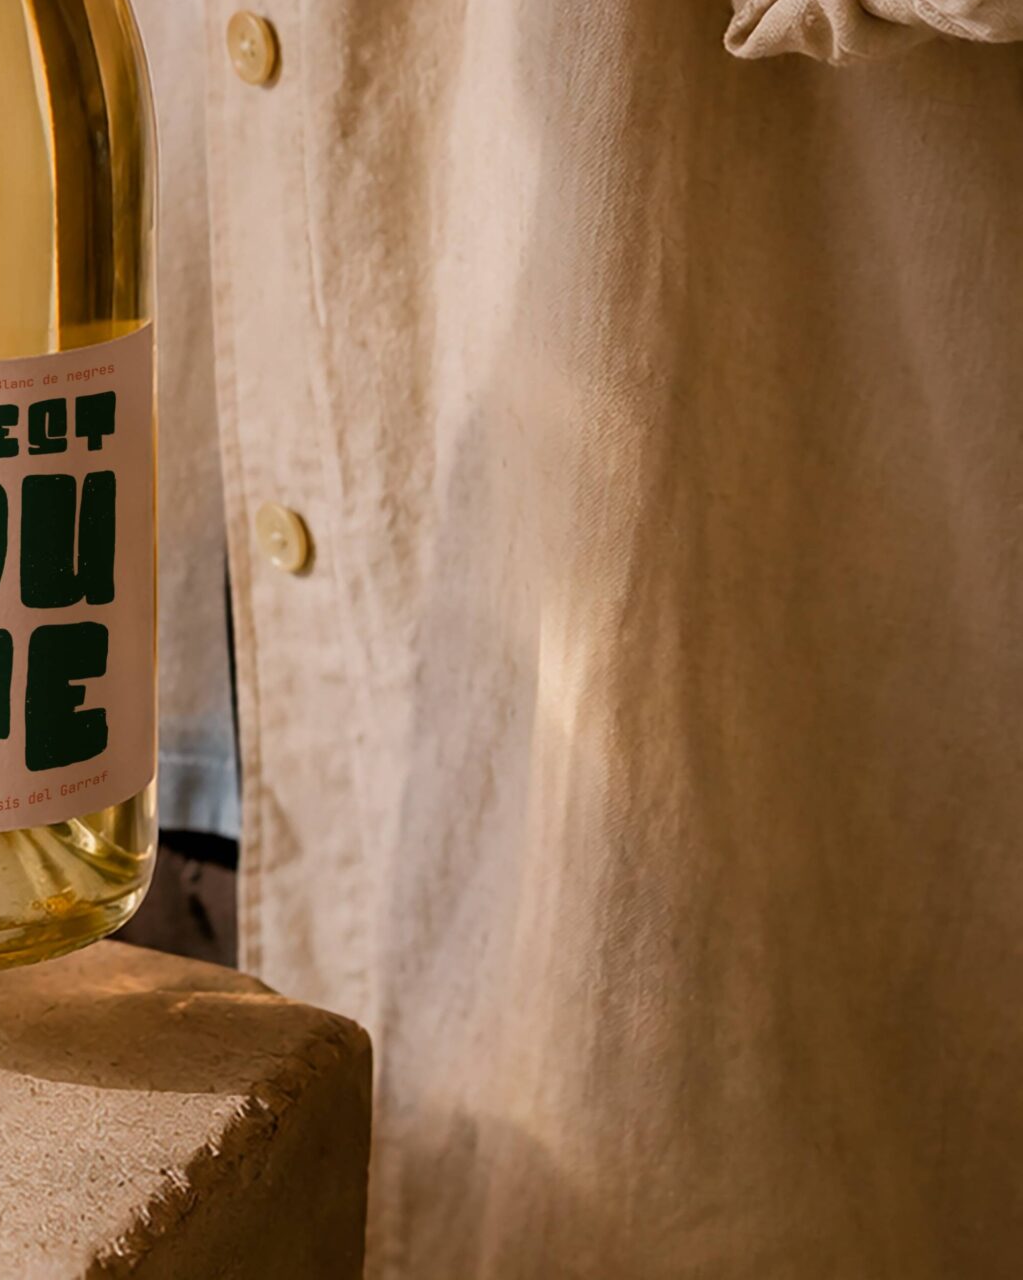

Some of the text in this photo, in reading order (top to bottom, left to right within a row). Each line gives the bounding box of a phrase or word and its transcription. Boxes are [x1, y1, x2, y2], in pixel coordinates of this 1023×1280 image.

[42, 373, 58, 386] de
[66, 363, 115, 382] negres
[28, 788, 52, 805] del
[60, 771, 109, 797] Garraf
